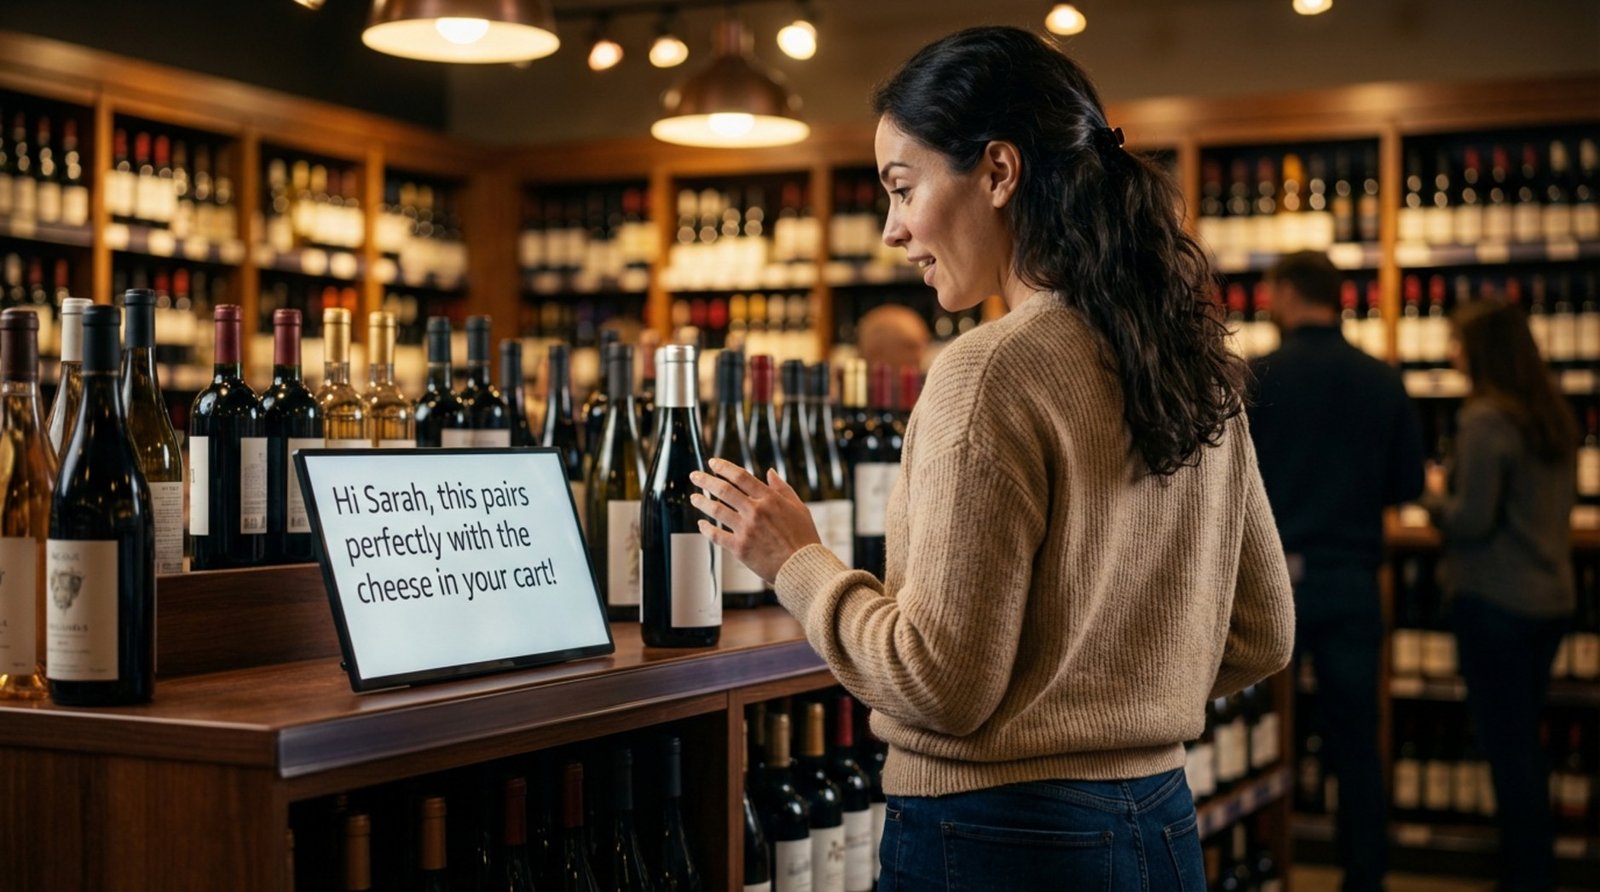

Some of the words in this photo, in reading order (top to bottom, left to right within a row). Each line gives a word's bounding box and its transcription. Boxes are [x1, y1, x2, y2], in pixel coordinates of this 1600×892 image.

[333, 485, 361, 514] Hi
[364, 482, 435, 515] Sarah,
[437, 481, 478, 509] this
[481, 480, 530, 514] pairs
[346, 525, 442, 567] perfectly
[447, 521, 494, 551] with
[497, 520, 532, 547] the
[357, 573, 434, 603] cheese
[436, 568, 459, 595] in
[462, 569, 507, 601] your
[514, 558, 557, 588] cart!
